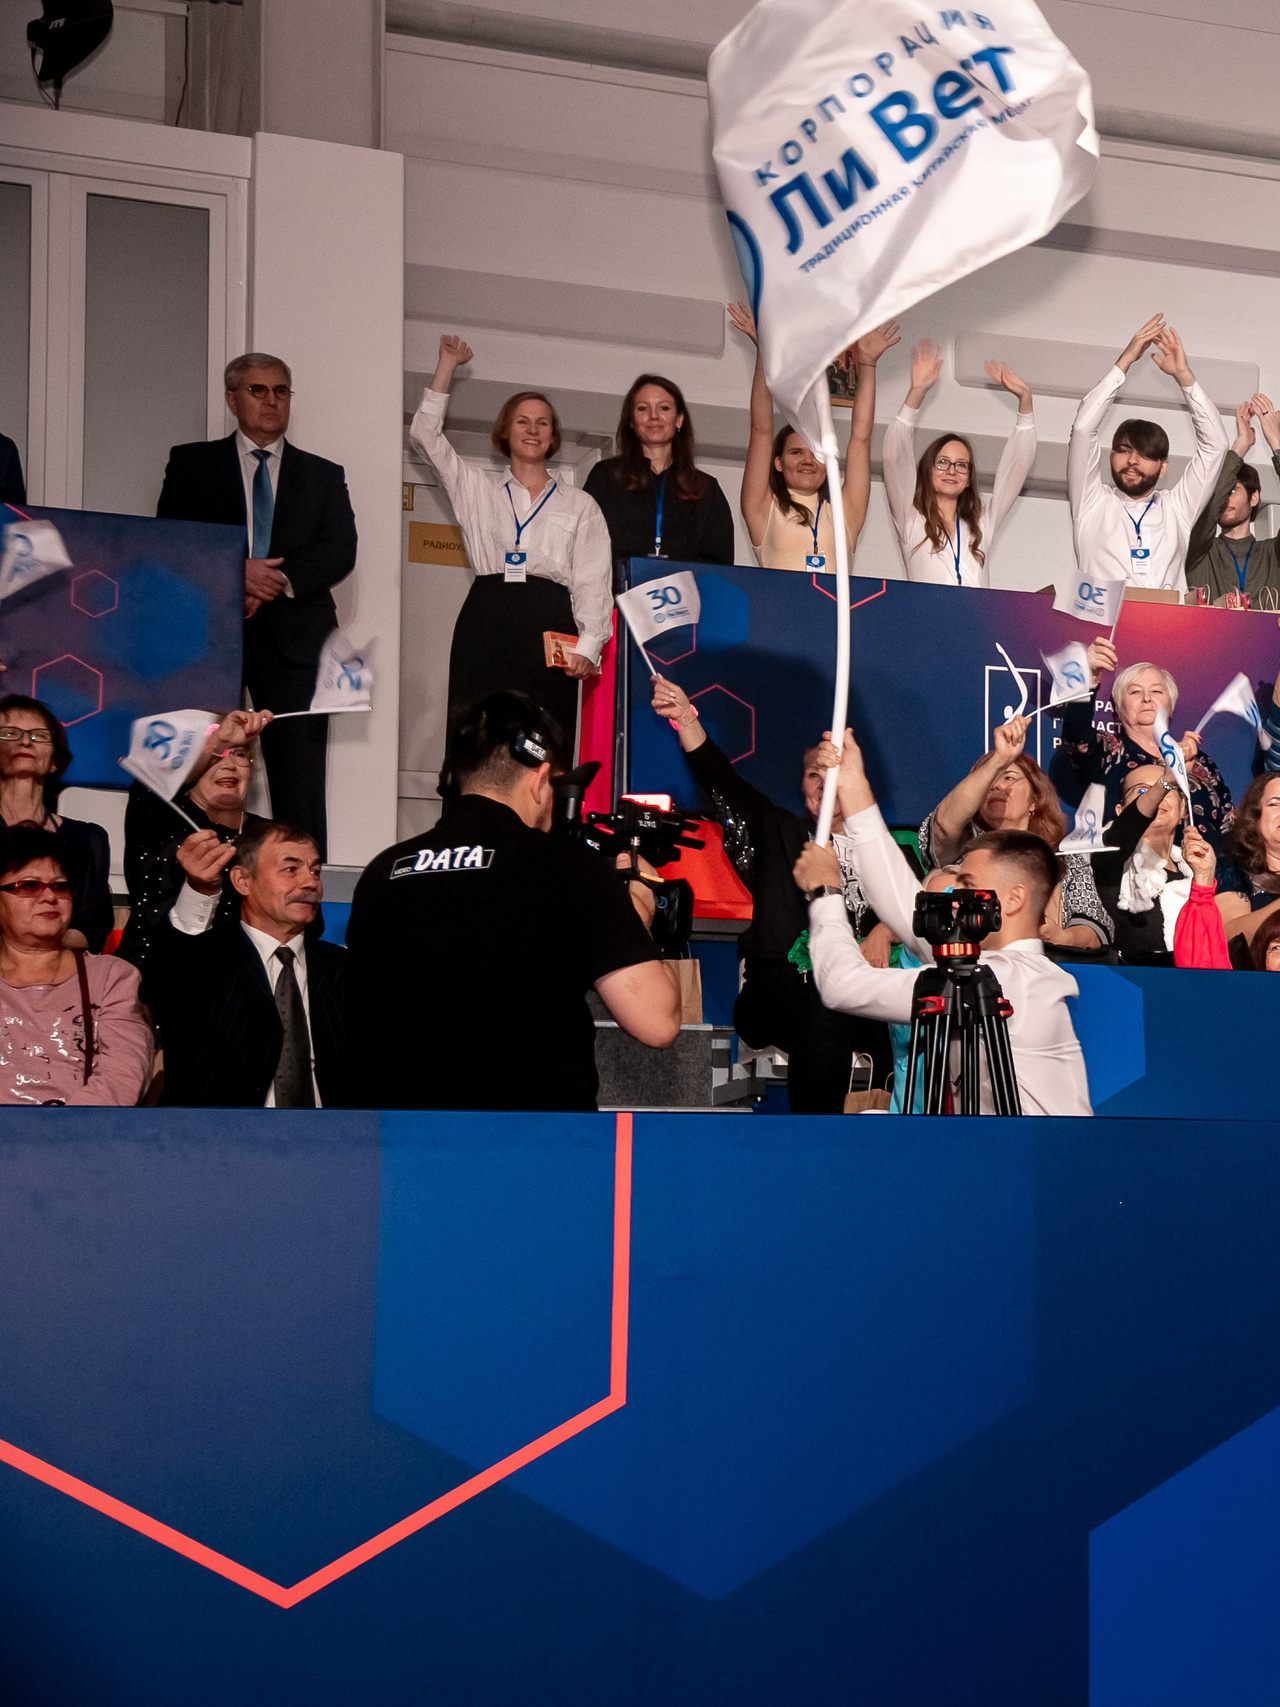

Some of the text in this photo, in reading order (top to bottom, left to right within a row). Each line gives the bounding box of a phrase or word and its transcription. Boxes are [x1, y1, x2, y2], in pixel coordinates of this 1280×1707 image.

[753, 9, 996, 187] КОРПОРАЦИЯ
[769, 147, 881, 256] Ли
[799, 187, 910, 273] ТРАДИЦИОННАЯ
[423, 539, 465, 551] РАДИОУ
[646, 586, 682, 610] 30
[394, 845, 483, 875] VIDEO DATA
